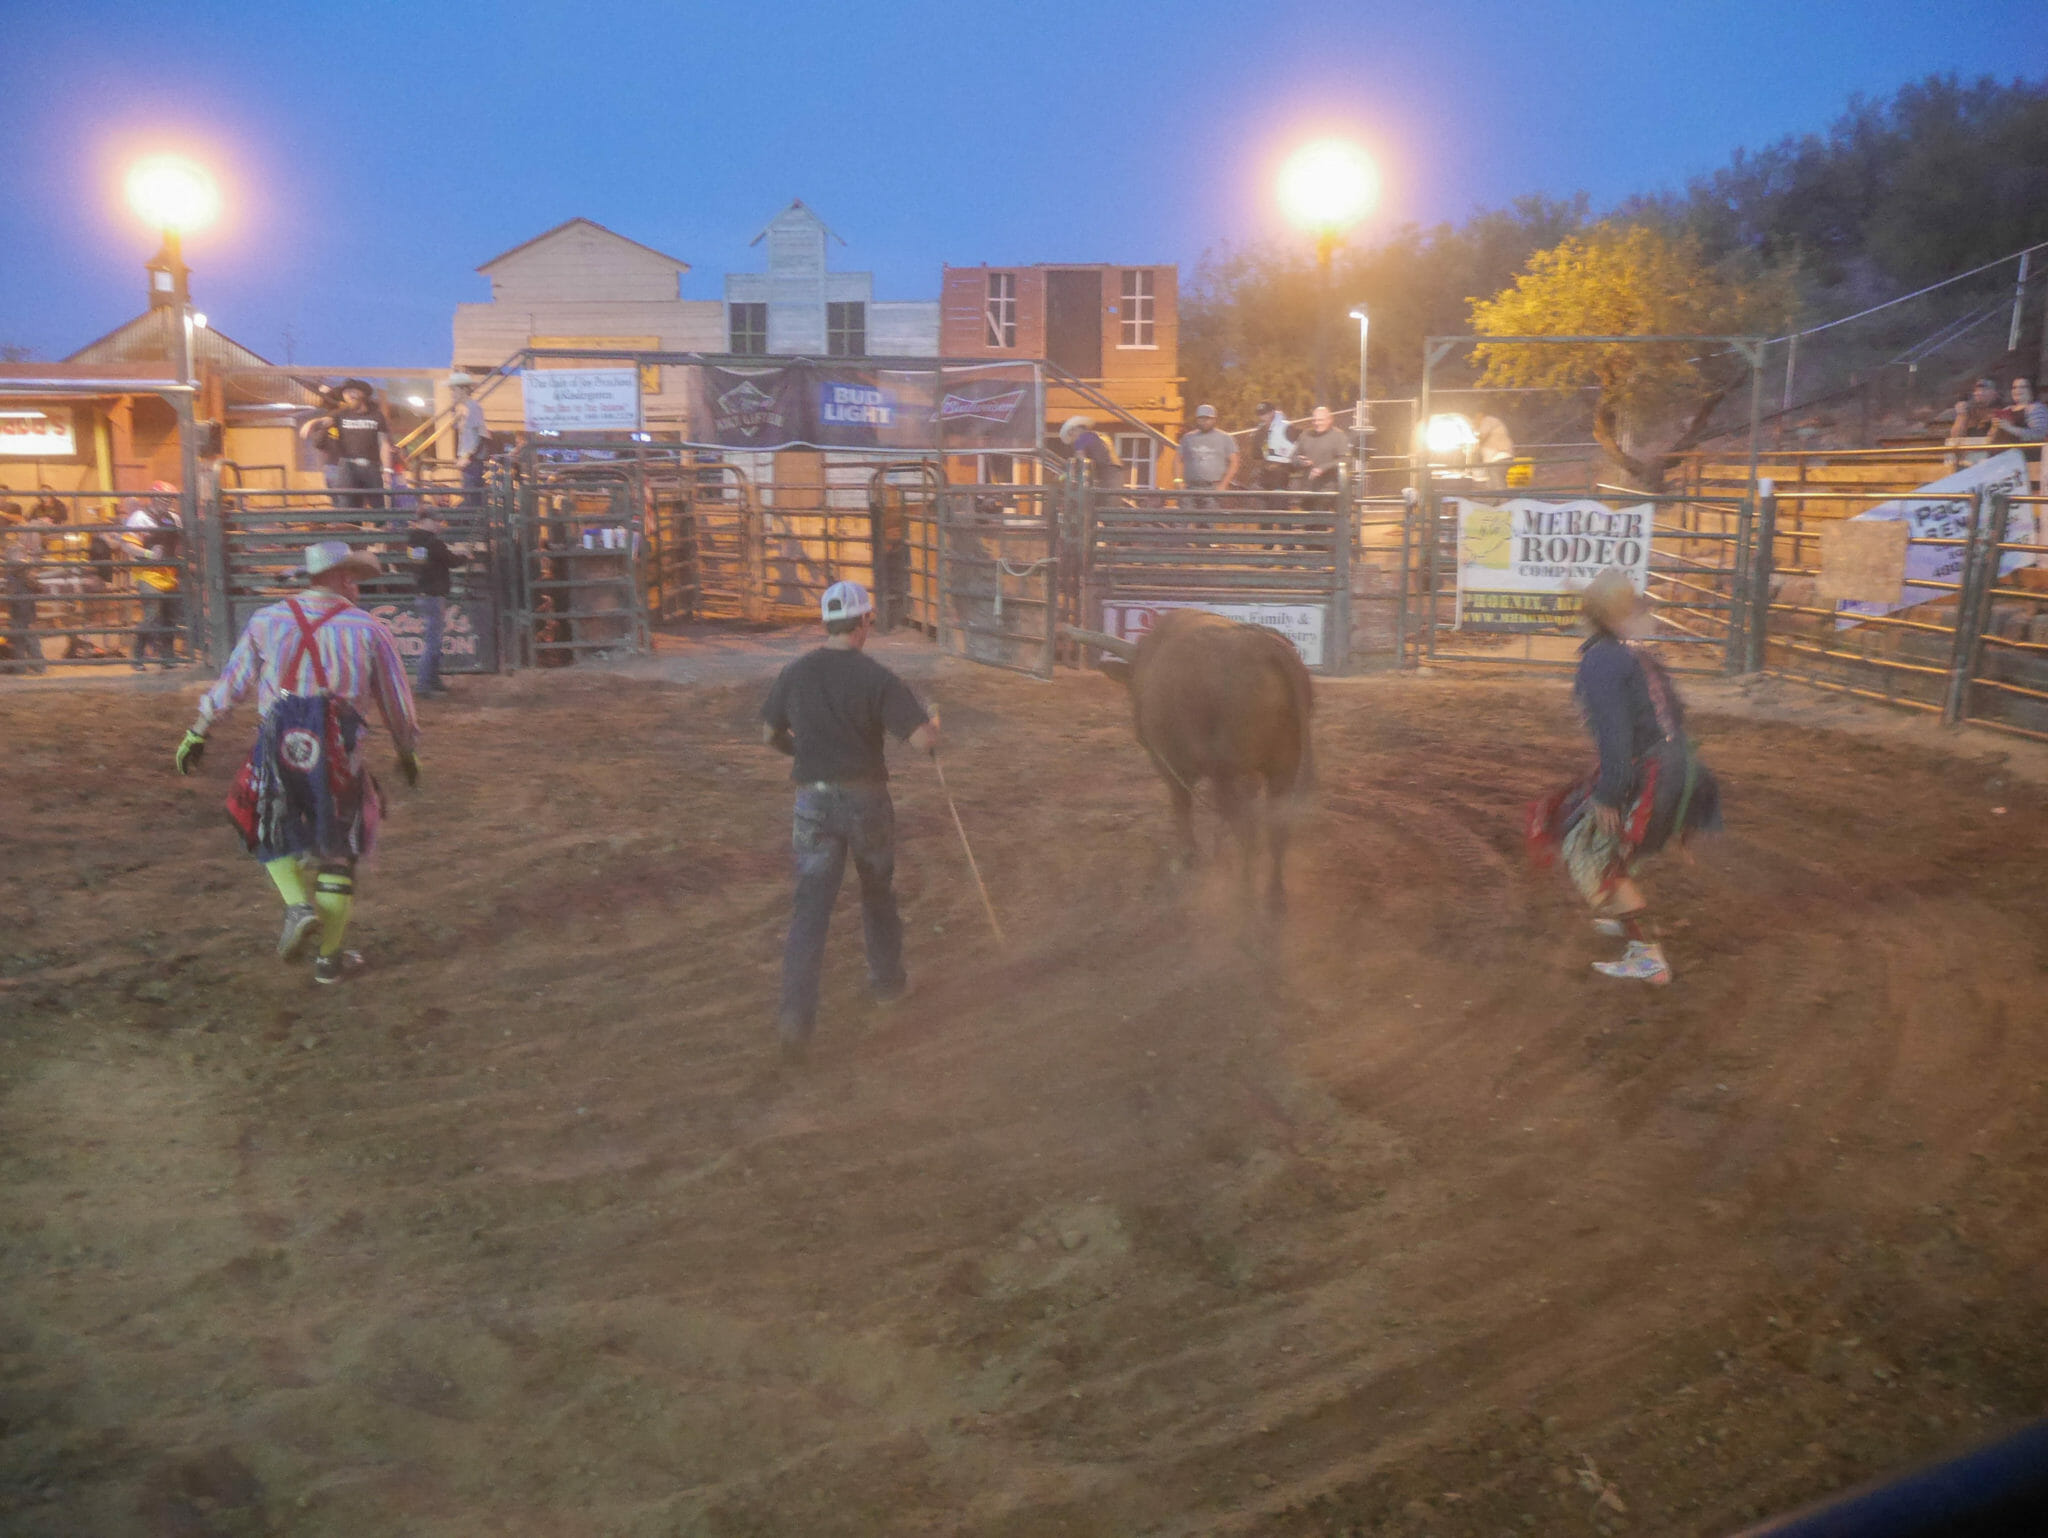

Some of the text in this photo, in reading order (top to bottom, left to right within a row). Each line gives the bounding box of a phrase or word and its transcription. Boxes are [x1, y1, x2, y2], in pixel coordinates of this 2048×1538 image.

[833, 387, 882, 405] BUD
[824, 403, 891, 424] LIGHT
[1523, 509, 1644, 538] MERCER
[1519, 536, 1641, 566] RODEO
[1250, 611, 1294, 628] Family
